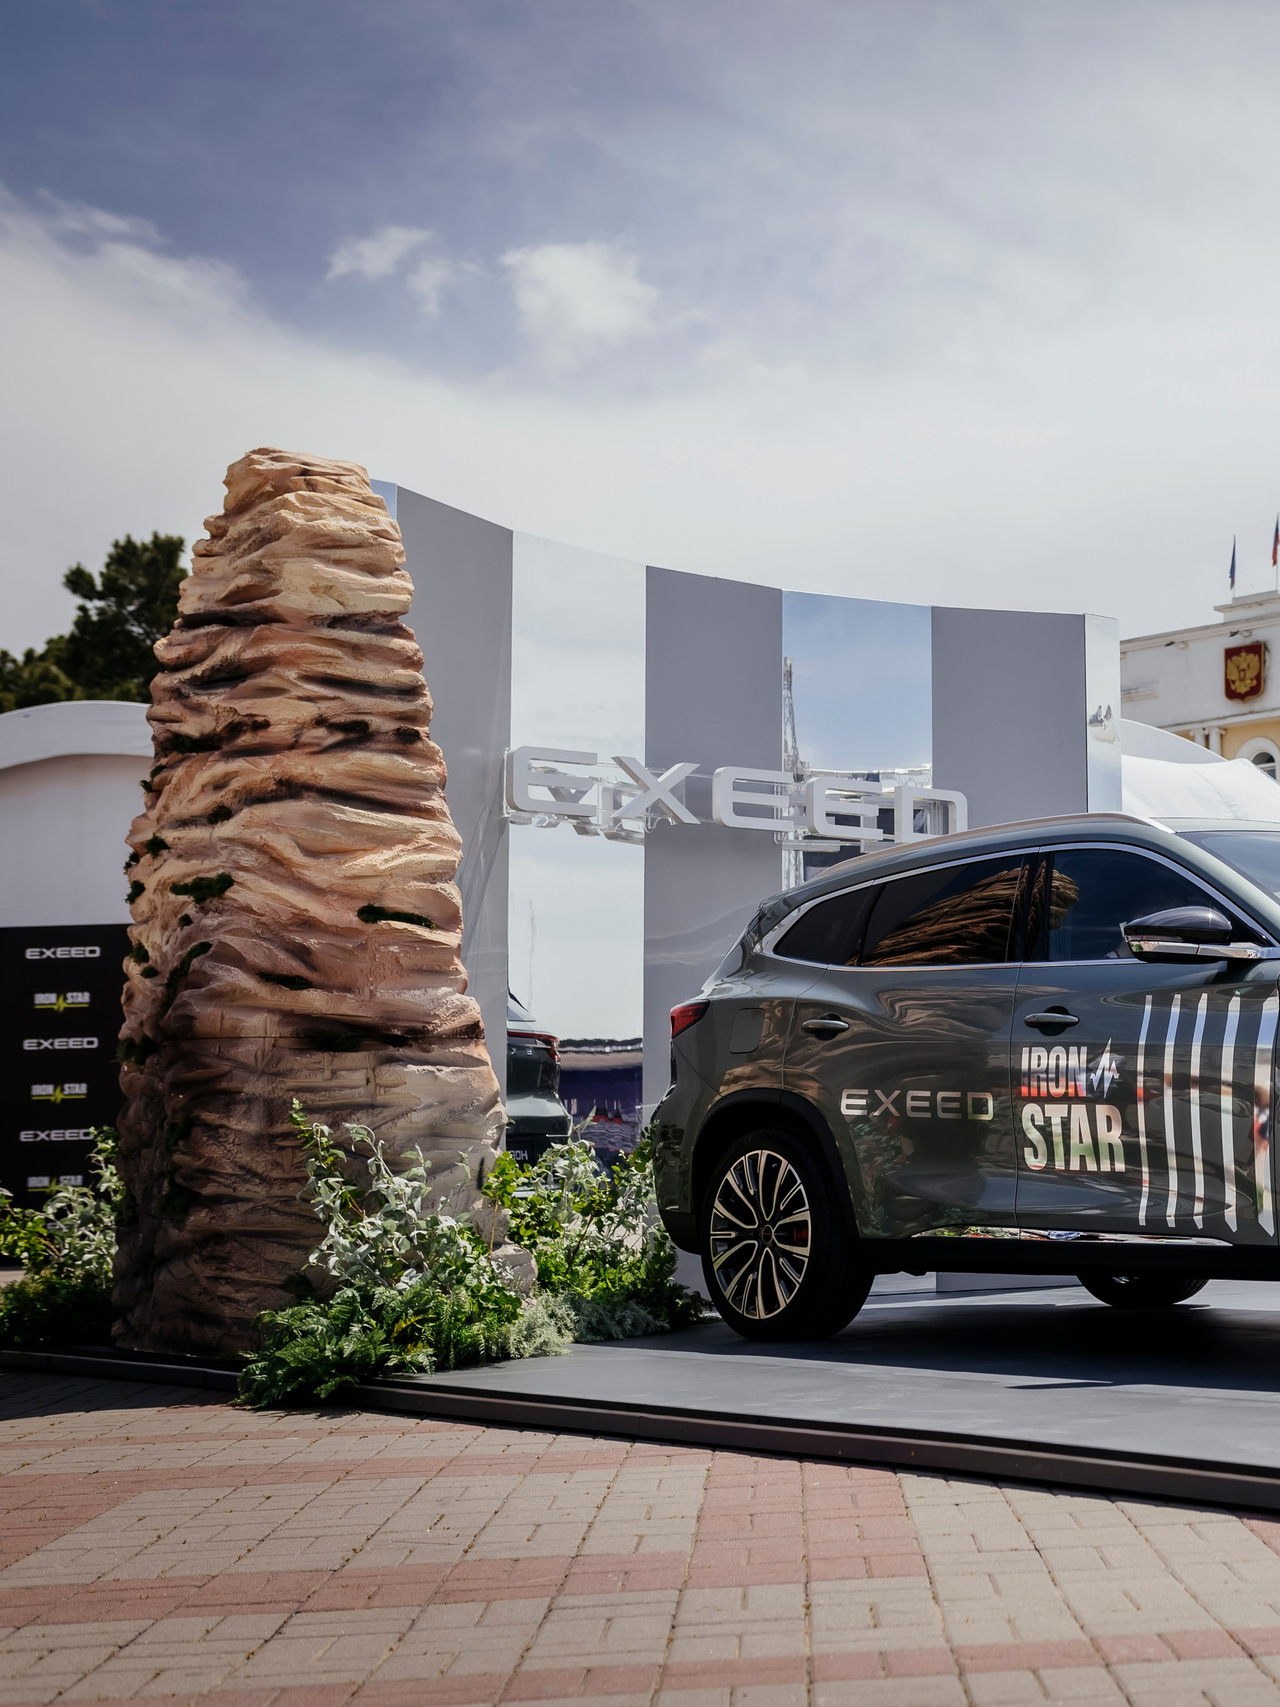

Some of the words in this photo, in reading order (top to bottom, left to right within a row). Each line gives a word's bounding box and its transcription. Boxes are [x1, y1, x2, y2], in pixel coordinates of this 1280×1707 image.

[506, 745, 968, 843] EXEED
[25, 946, 101, 960] EXEED
[66, 992, 90, 1003] STAR
[23, 1037, 98, 1050] EXEED
[1021, 1046, 1087, 1097] IRON
[63, 1083, 87, 1095] STAR
[841, 1088, 994, 1121] EXEED
[1021, 1103, 1126, 1173] STAR
